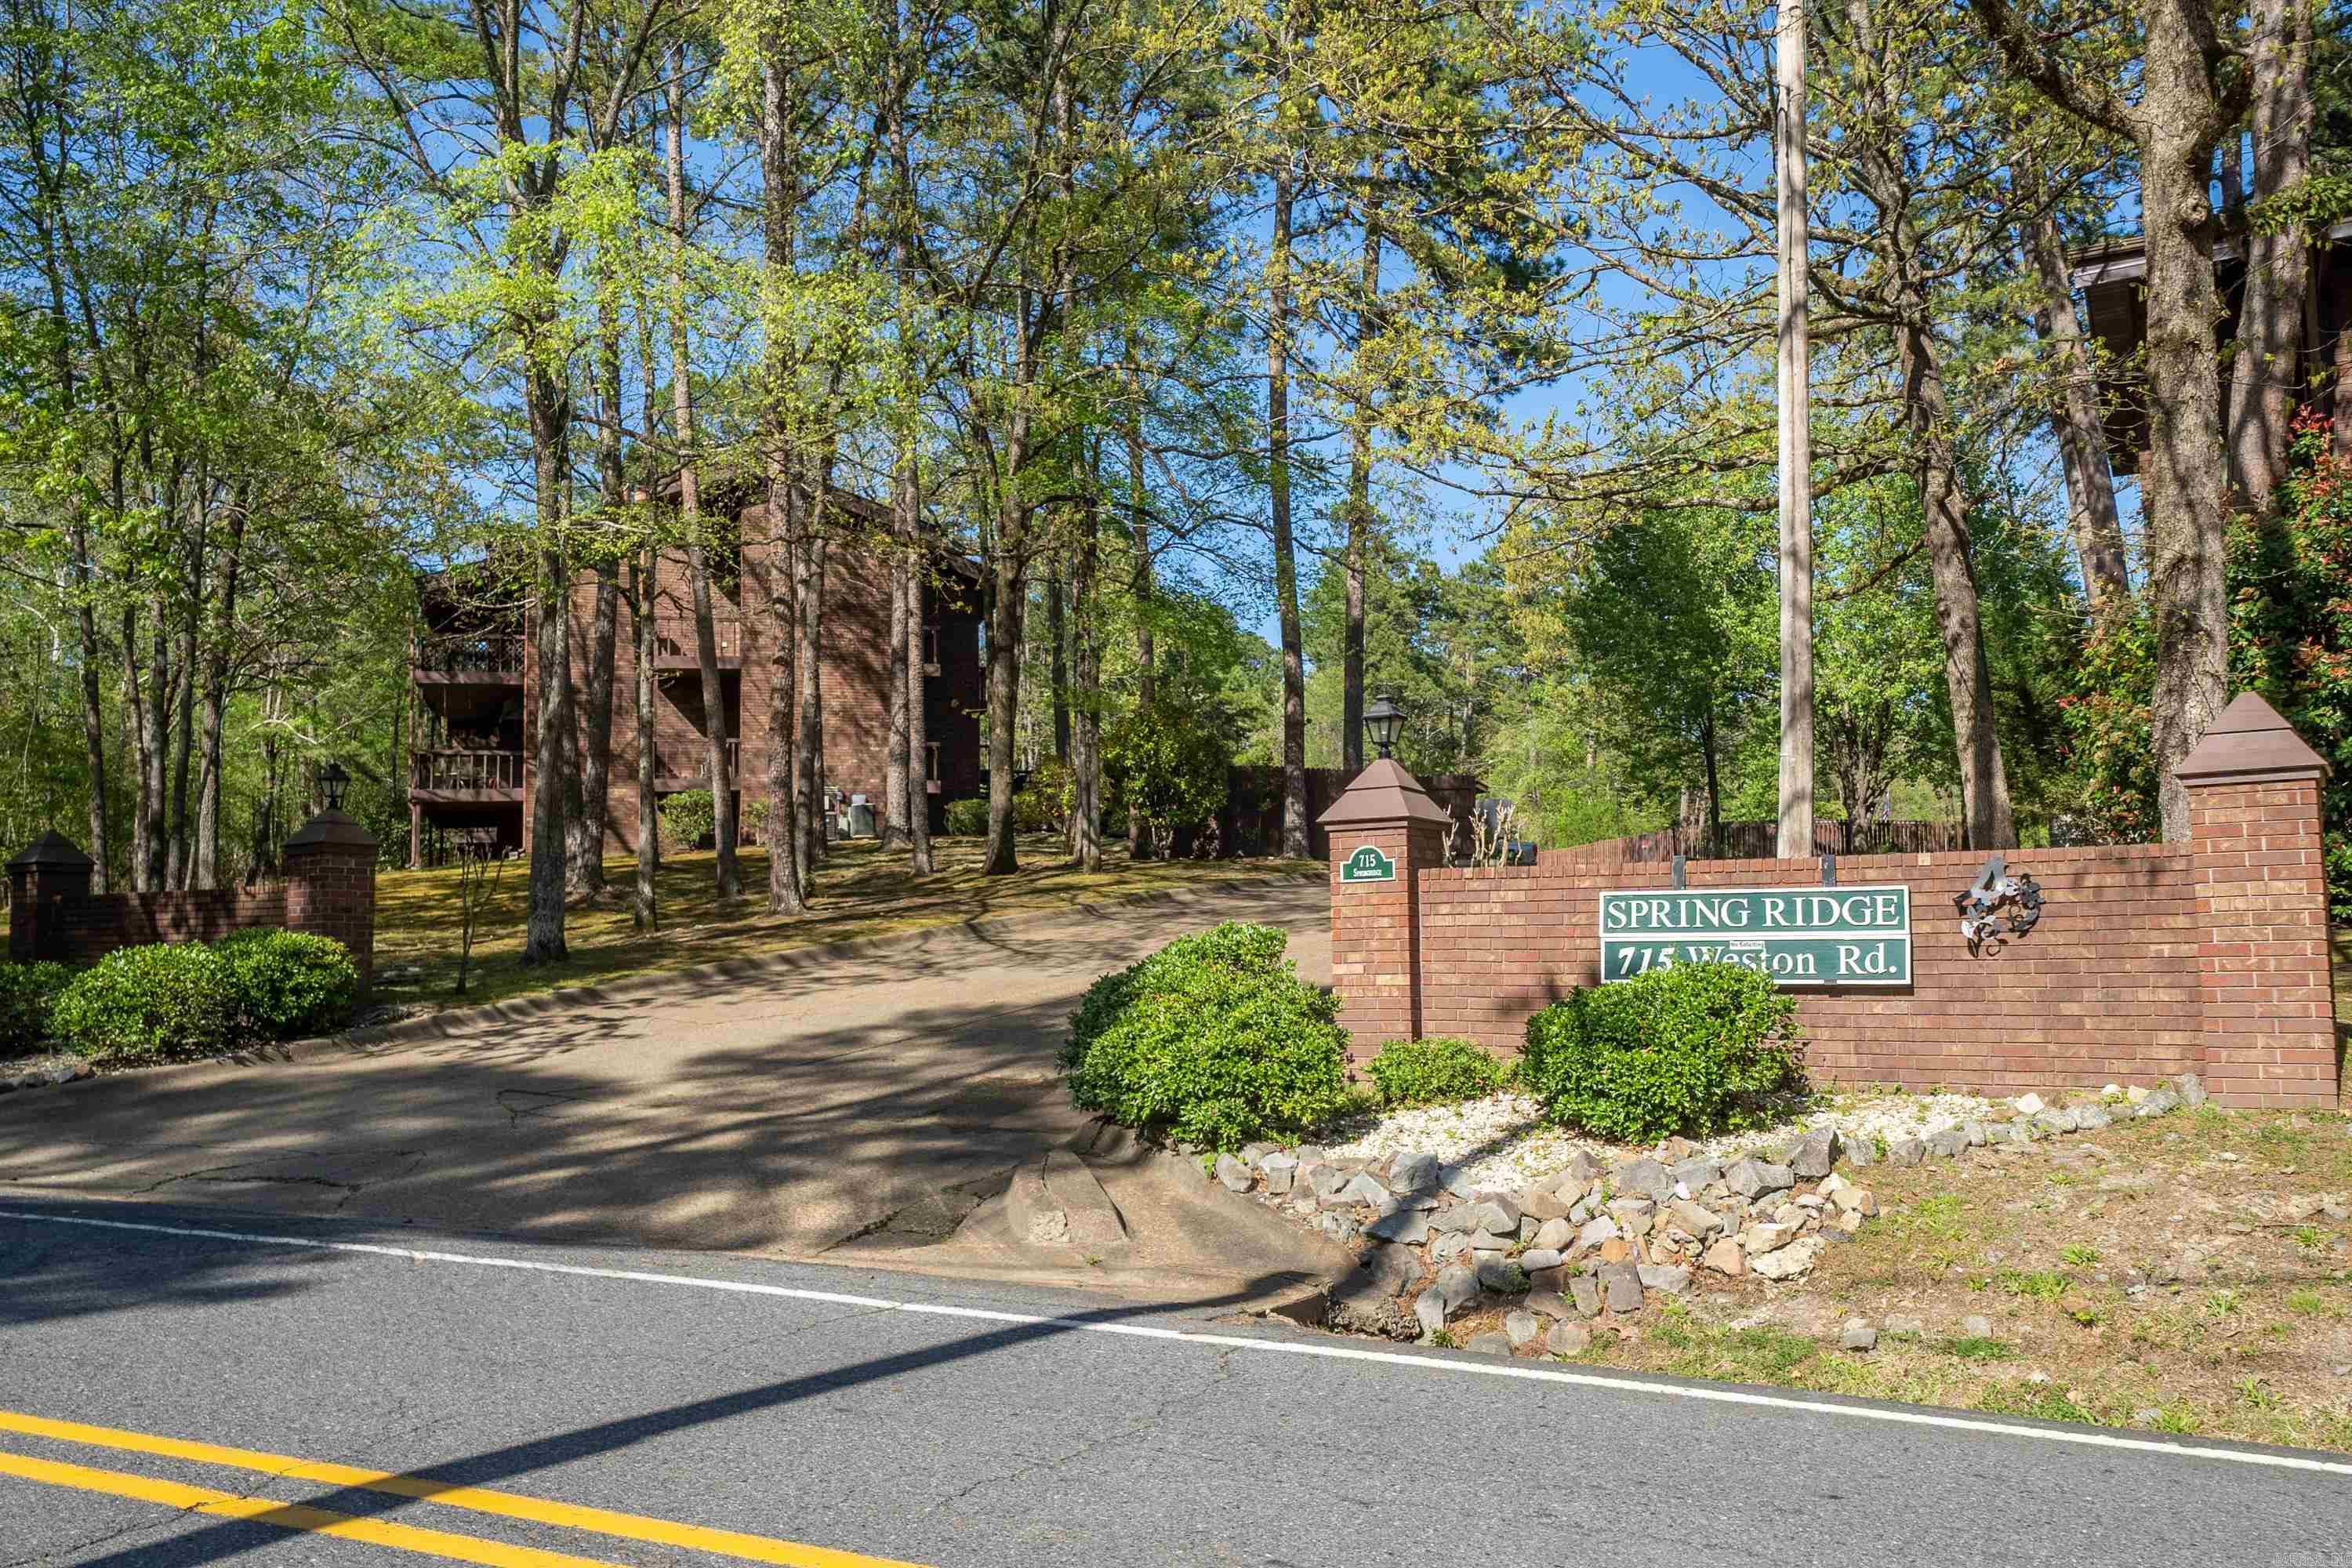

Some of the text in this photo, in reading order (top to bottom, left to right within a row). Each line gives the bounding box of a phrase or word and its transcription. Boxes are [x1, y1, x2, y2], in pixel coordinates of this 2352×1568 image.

[1359, 855, 1376, 868] 715
[1607, 895, 1900, 928] SPRING RIDGE
[1617, 946, 1675, 975] 715
[1835, 942, 1897, 975] Rd.
